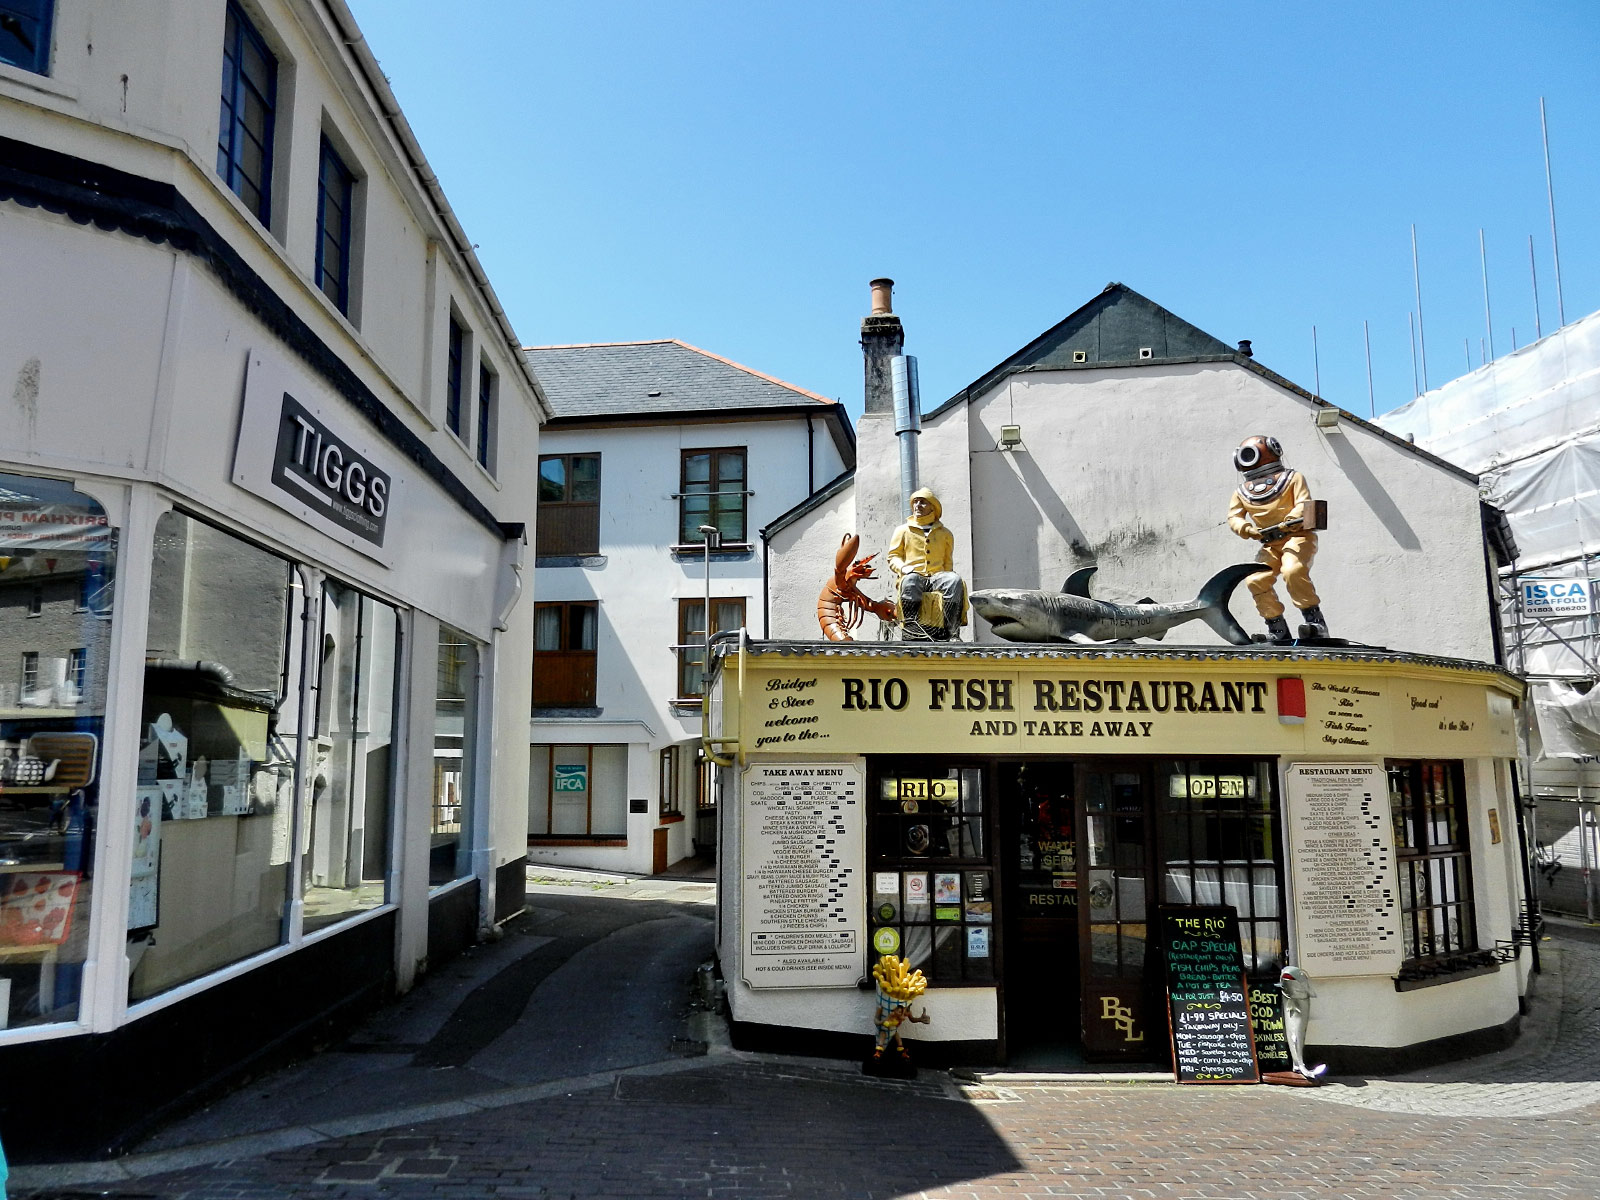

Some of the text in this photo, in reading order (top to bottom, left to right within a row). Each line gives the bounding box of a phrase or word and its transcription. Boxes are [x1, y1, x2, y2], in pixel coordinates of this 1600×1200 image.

[296, 414, 387, 518] TIGGS
[1525, 583, 1585, 599] ISCA
[1526, 597, 1587, 606] SCAFFOLD
[1137, 617, 1151, 625] YOU
[766, 678, 817, 691] Bridget
[1312, 682, 1380, 696] The World Famous
[841, 678, 1268, 713] RIO FISH RESTAURANT
[768, 696, 815, 709] & Steve
[765, 715, 819, 727] welcome
[970, 721, 1153, 737] AND TAKE AWAY
[755, 736, 781, 748] you
[783, 733, 796, 742] to
[1322, 734, 1370, 746] Sky Atlantic
[556, 779, 583, 790] IFCA
[901, 782, 946, 798] RIO
[1191, 780, 1243, 796] OPEN
[1172, 940, 1237, 953] OAP SPECIAL
[1172, 992, 1184, 1000] ALL
[1252, 990, 1278, 1004] BEST
[1208, 1011, 1247, 1020] SPECIALS
[1251, 1004, 1273, 1018] COD
[1261, 1017, 1284, 1030] TOWN
[1197, 1033, 1224, 1041] Sausage
[1254, 1033, 1284, 1042] SKINLESS
[1258, 1051, 1288, 1060] BONELESS
